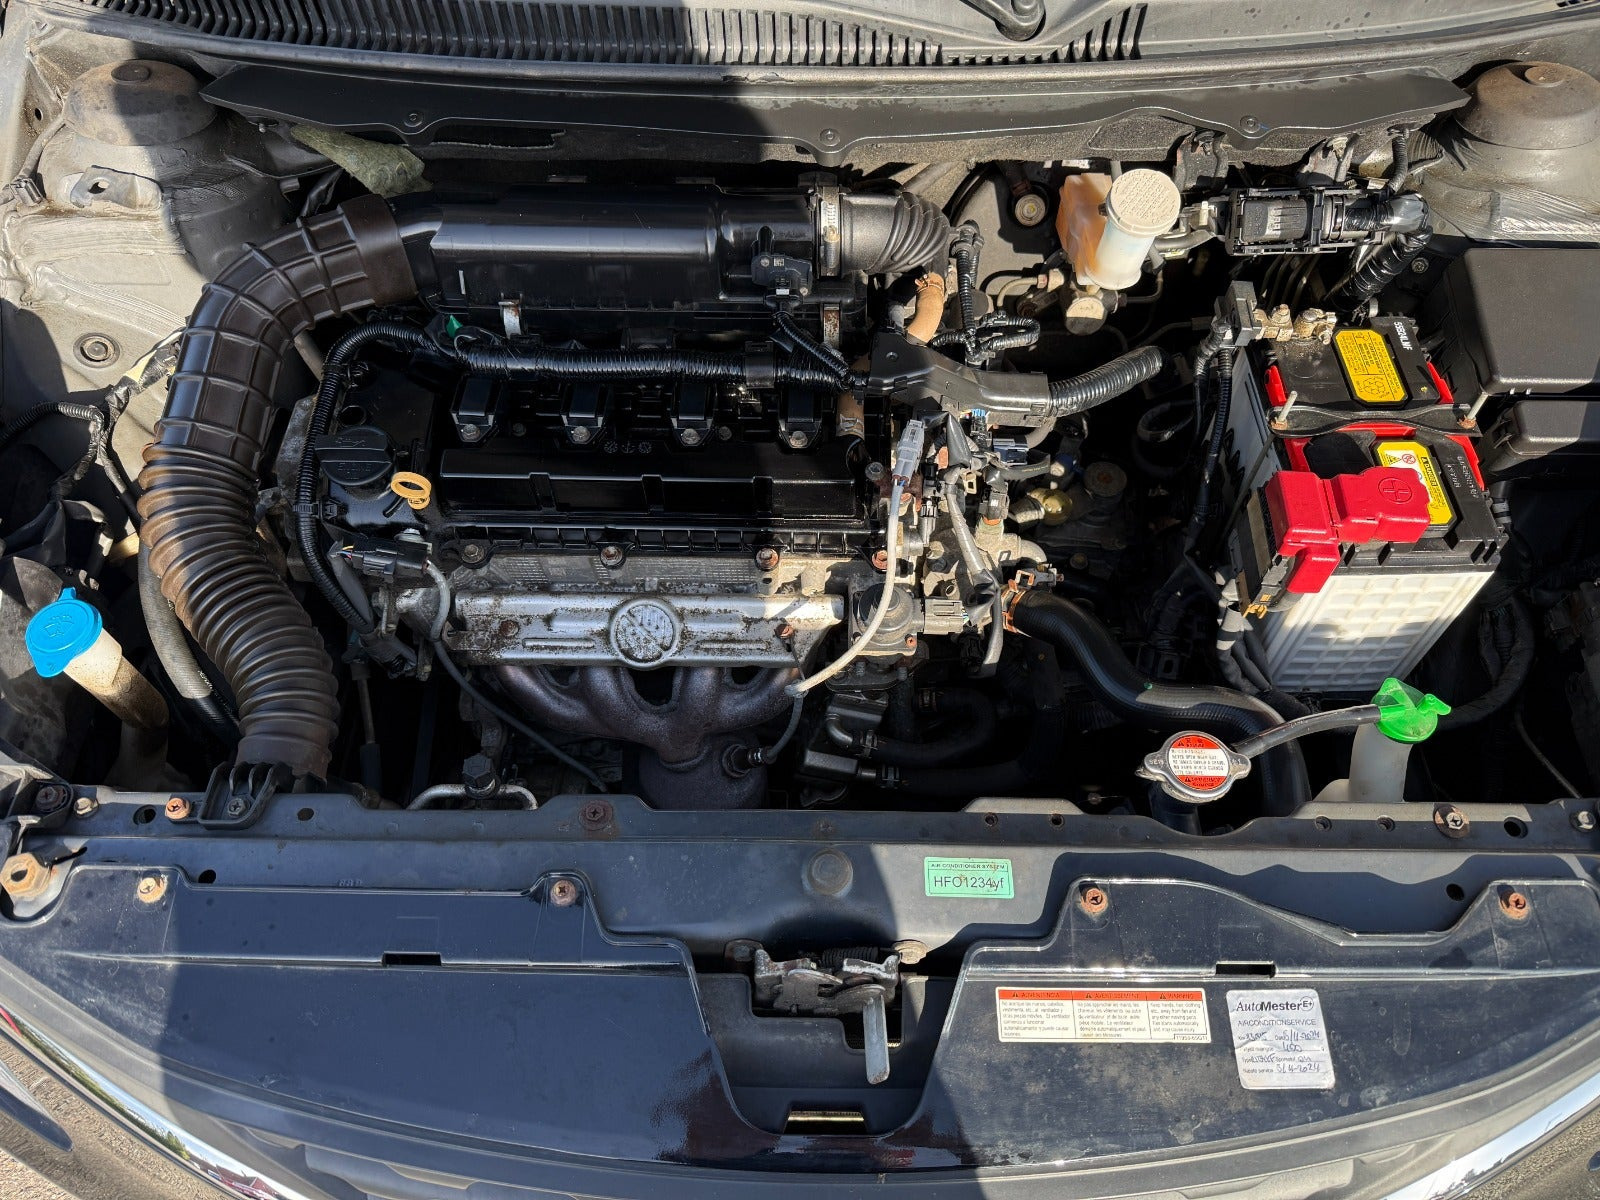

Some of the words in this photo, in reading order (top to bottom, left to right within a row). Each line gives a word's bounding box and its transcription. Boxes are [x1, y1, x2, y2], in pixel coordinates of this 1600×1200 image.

[934, 876, 1004, 891] HFO1234yf
[1236, 1000, 1302, 1011] AutoMester
[1237, 1018, 1317, 1027] AIRCONDITIONSERVICE
